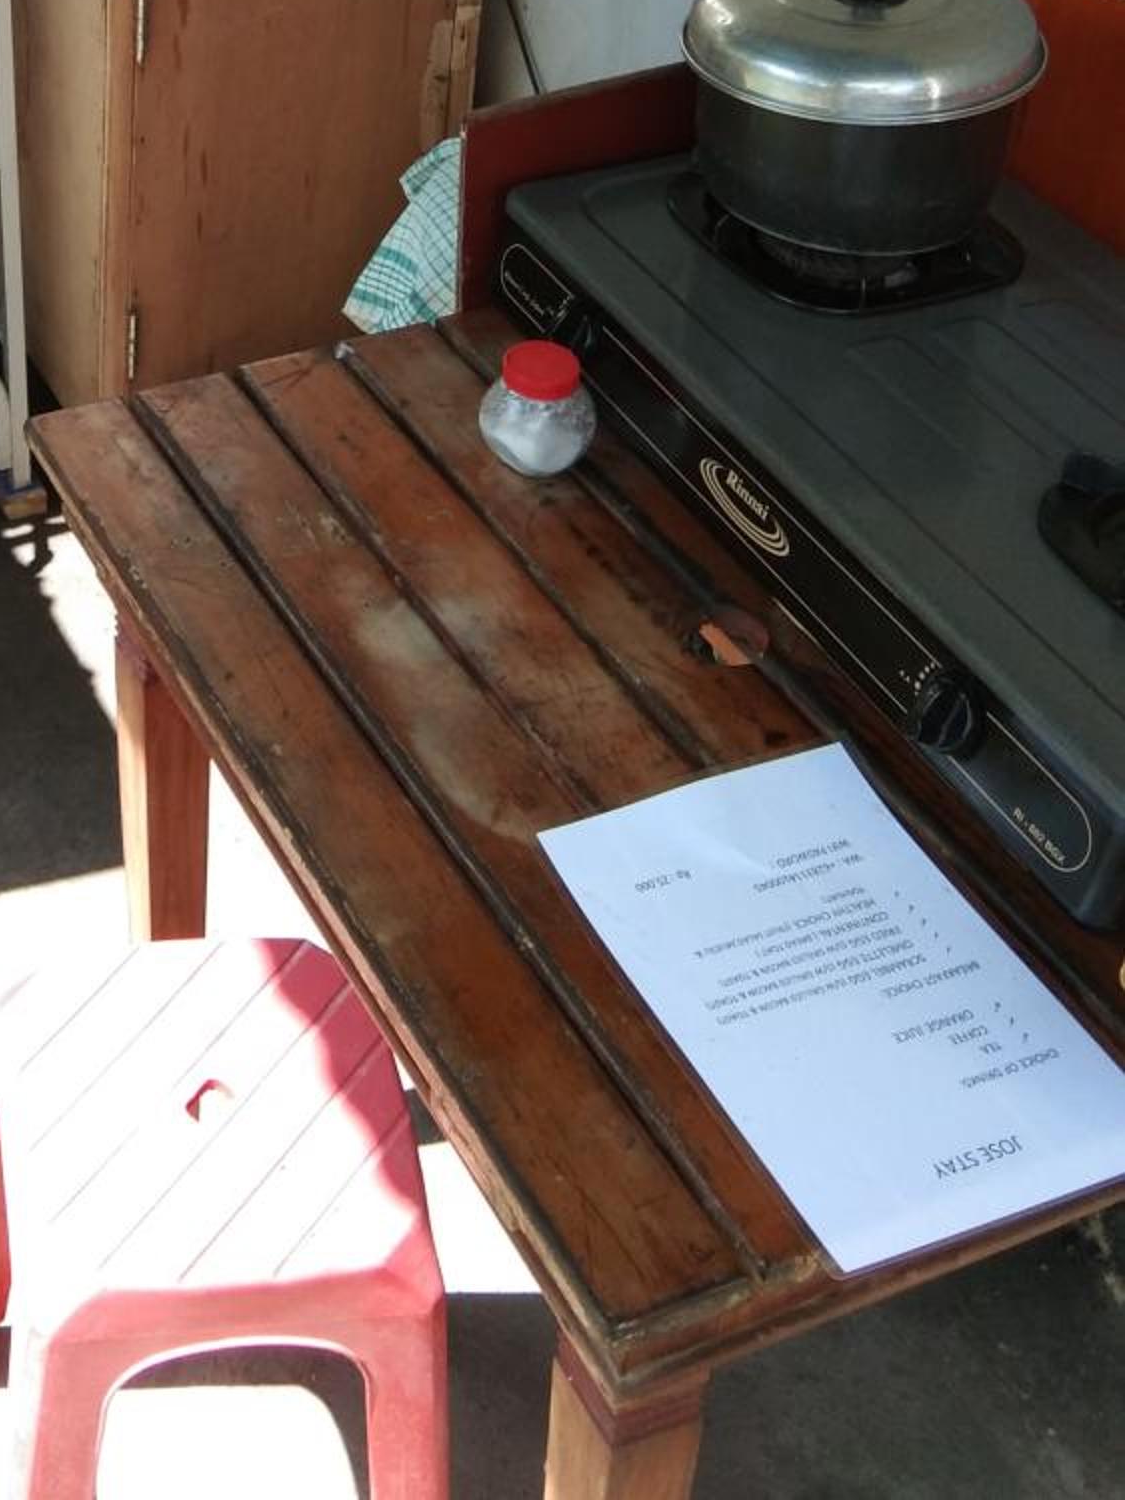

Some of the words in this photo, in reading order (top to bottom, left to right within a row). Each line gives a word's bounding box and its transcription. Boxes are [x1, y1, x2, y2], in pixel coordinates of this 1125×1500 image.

[726, 470, 770, 520] Rinnai
[892, 1024, 925, 1045] JUICE
[924, 1009, 975, 1034] ORANGE
[948, 1024, 989, 1045] COFFEE
[976, 1135, 1023, 1163] JOSE
[933, 1151, 980, 1180] STAY
